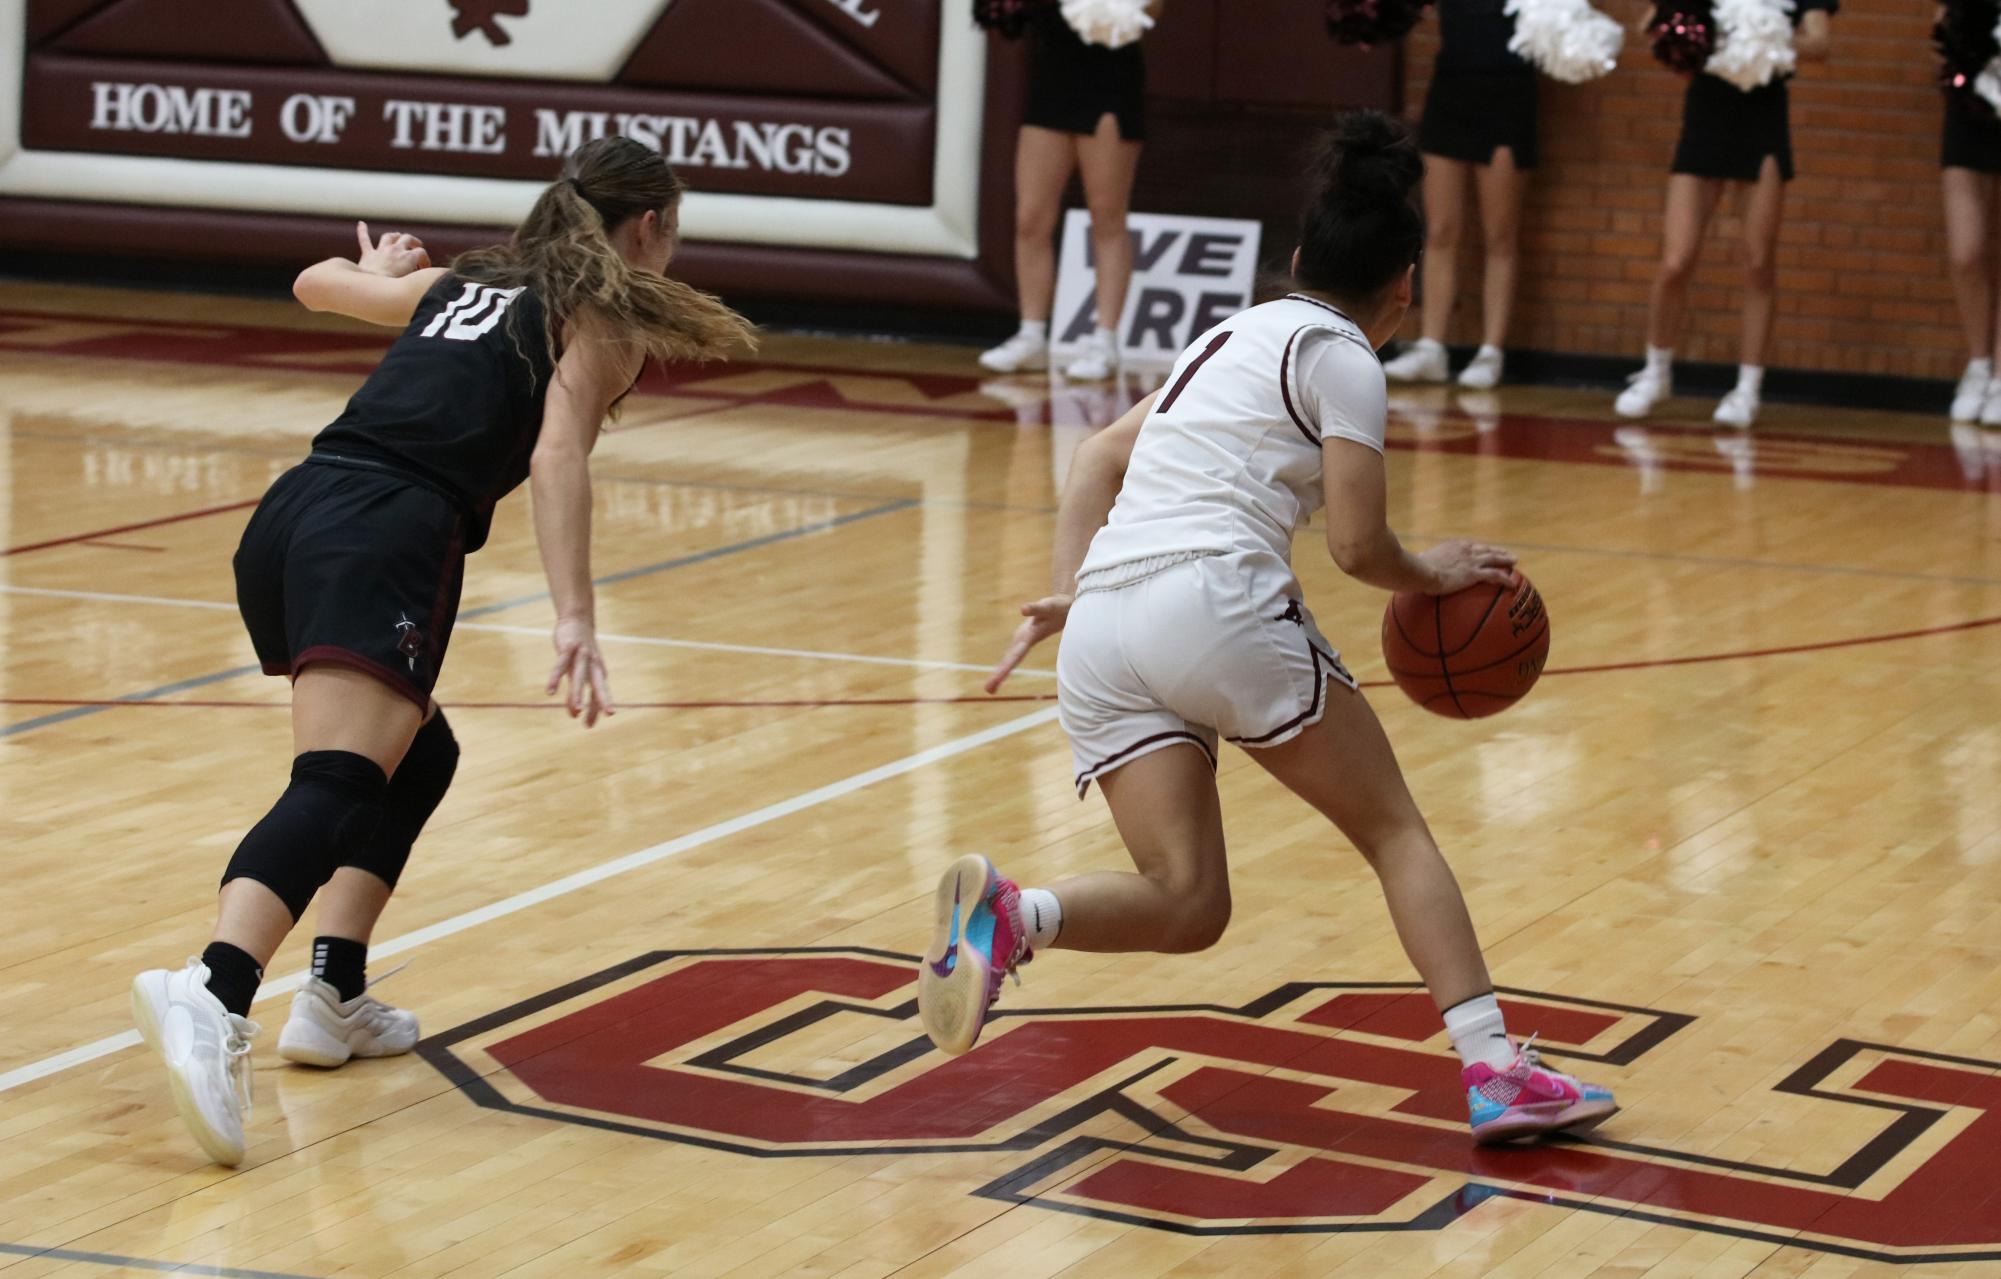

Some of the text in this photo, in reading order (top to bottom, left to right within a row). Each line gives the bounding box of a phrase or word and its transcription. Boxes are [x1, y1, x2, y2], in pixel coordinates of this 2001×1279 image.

[91, 82, 252, 137] HOME
[280, 94, 355, 144] OF
[383, 101, 504, 153] THE
[420, 282, 528, 341] 10
[1156, 331, 1233, 413] 1
